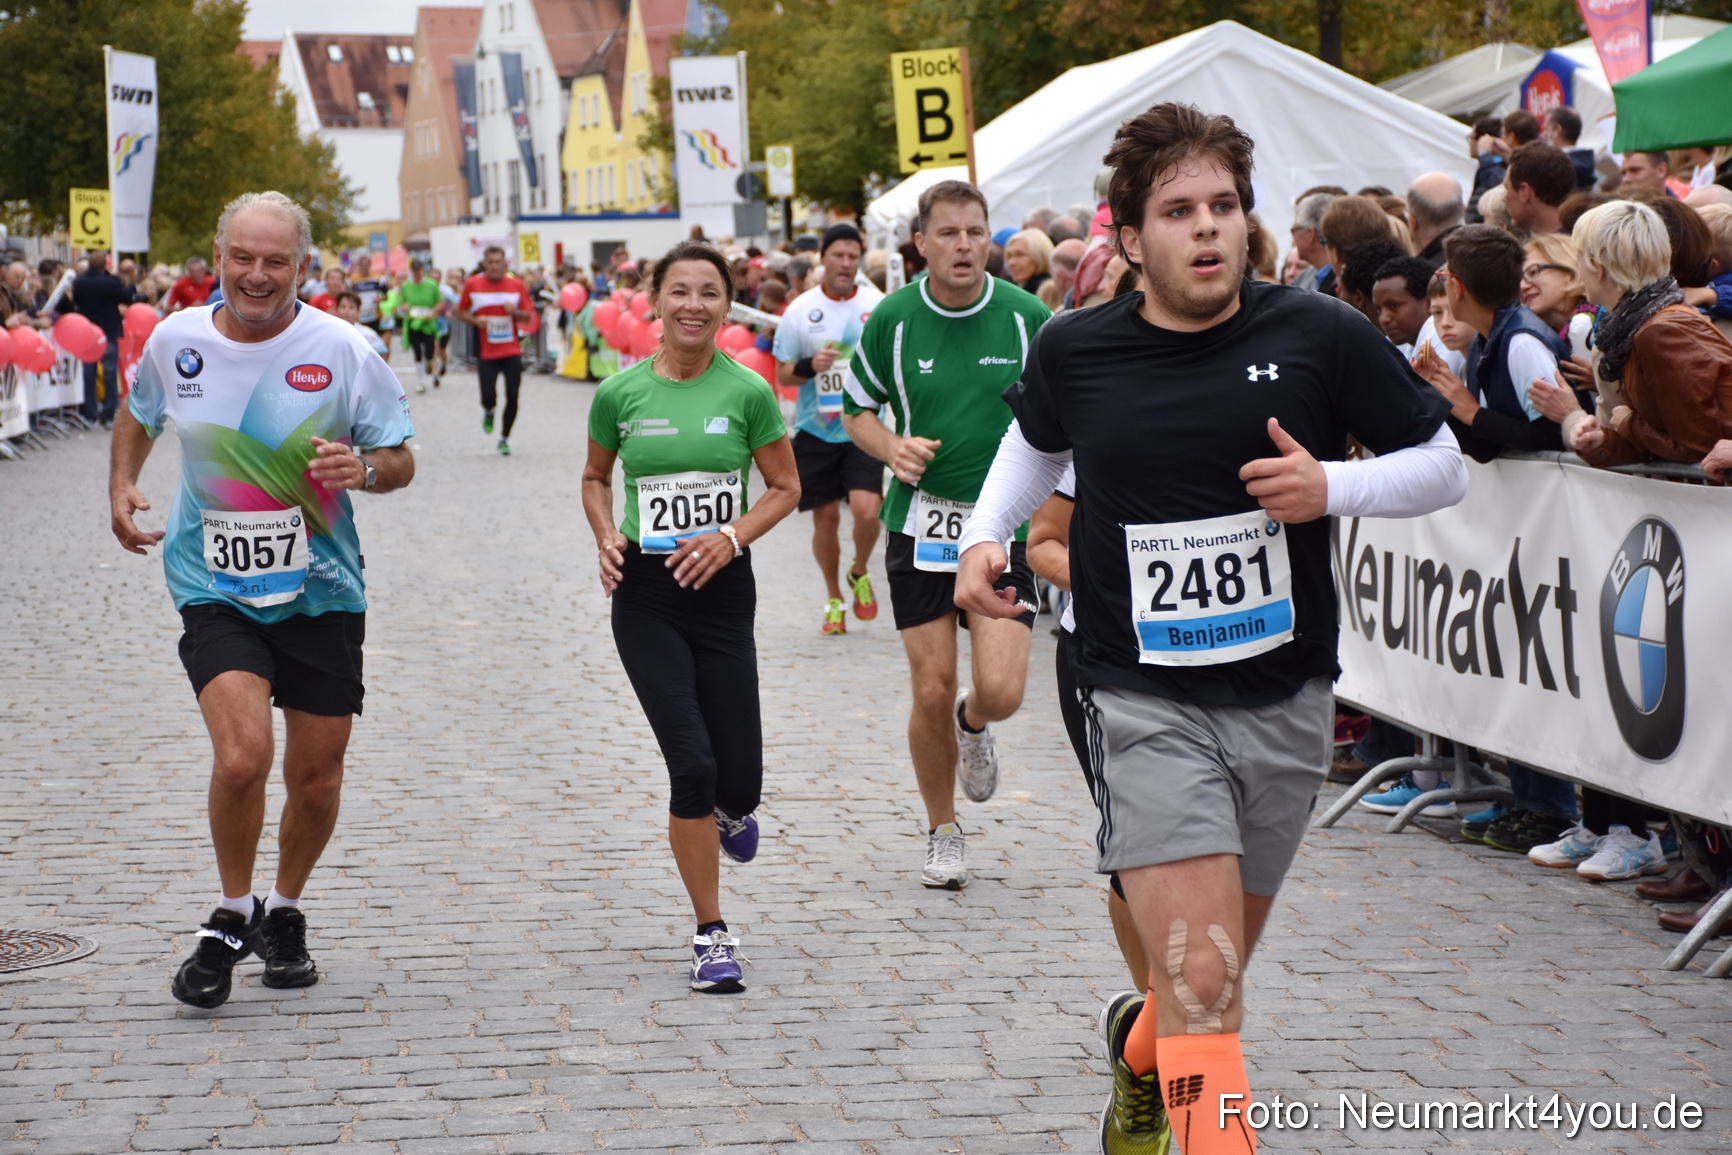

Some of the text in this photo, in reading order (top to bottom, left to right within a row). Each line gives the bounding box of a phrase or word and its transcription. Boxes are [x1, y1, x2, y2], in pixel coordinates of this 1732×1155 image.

[902, 54, 962, 78] Block
[111, 83, 153, 105] swn
[915, 87, 953, 144] B
[75, 190, 106, 205] Block
[80, 207, 100, 235] C
[978, 356, 1008, 366] africon
[176, 383, 204, 392] PARTL
[292, 370, 328, 385] Hervis
[820, 373, 842, 392] 30
[640, 478, 723, 493] PARTL Neumarkt
[650, 491, 733, 532] 2050
[921, 495, 949, 507] PARTL
[204, 518, 287, 531] PARTL Neumarkt
[926, 509, 963, 540] 26
[1131, 527, 1260, 552] PARTL Neumarkt
[213, 532, 297, 572] 3057
[942, 547, 958, 561] Ra
[1611, 523, 1684, 606] BMW
[229, 579, 269, 593] Toni
[1147, 545, 1272, 612] 2481
[1139, 610, 1146, 620] C
[1330, 516, 1581, 699] Neumarkt
[1168, 617, 1265, 648] Benjamin
